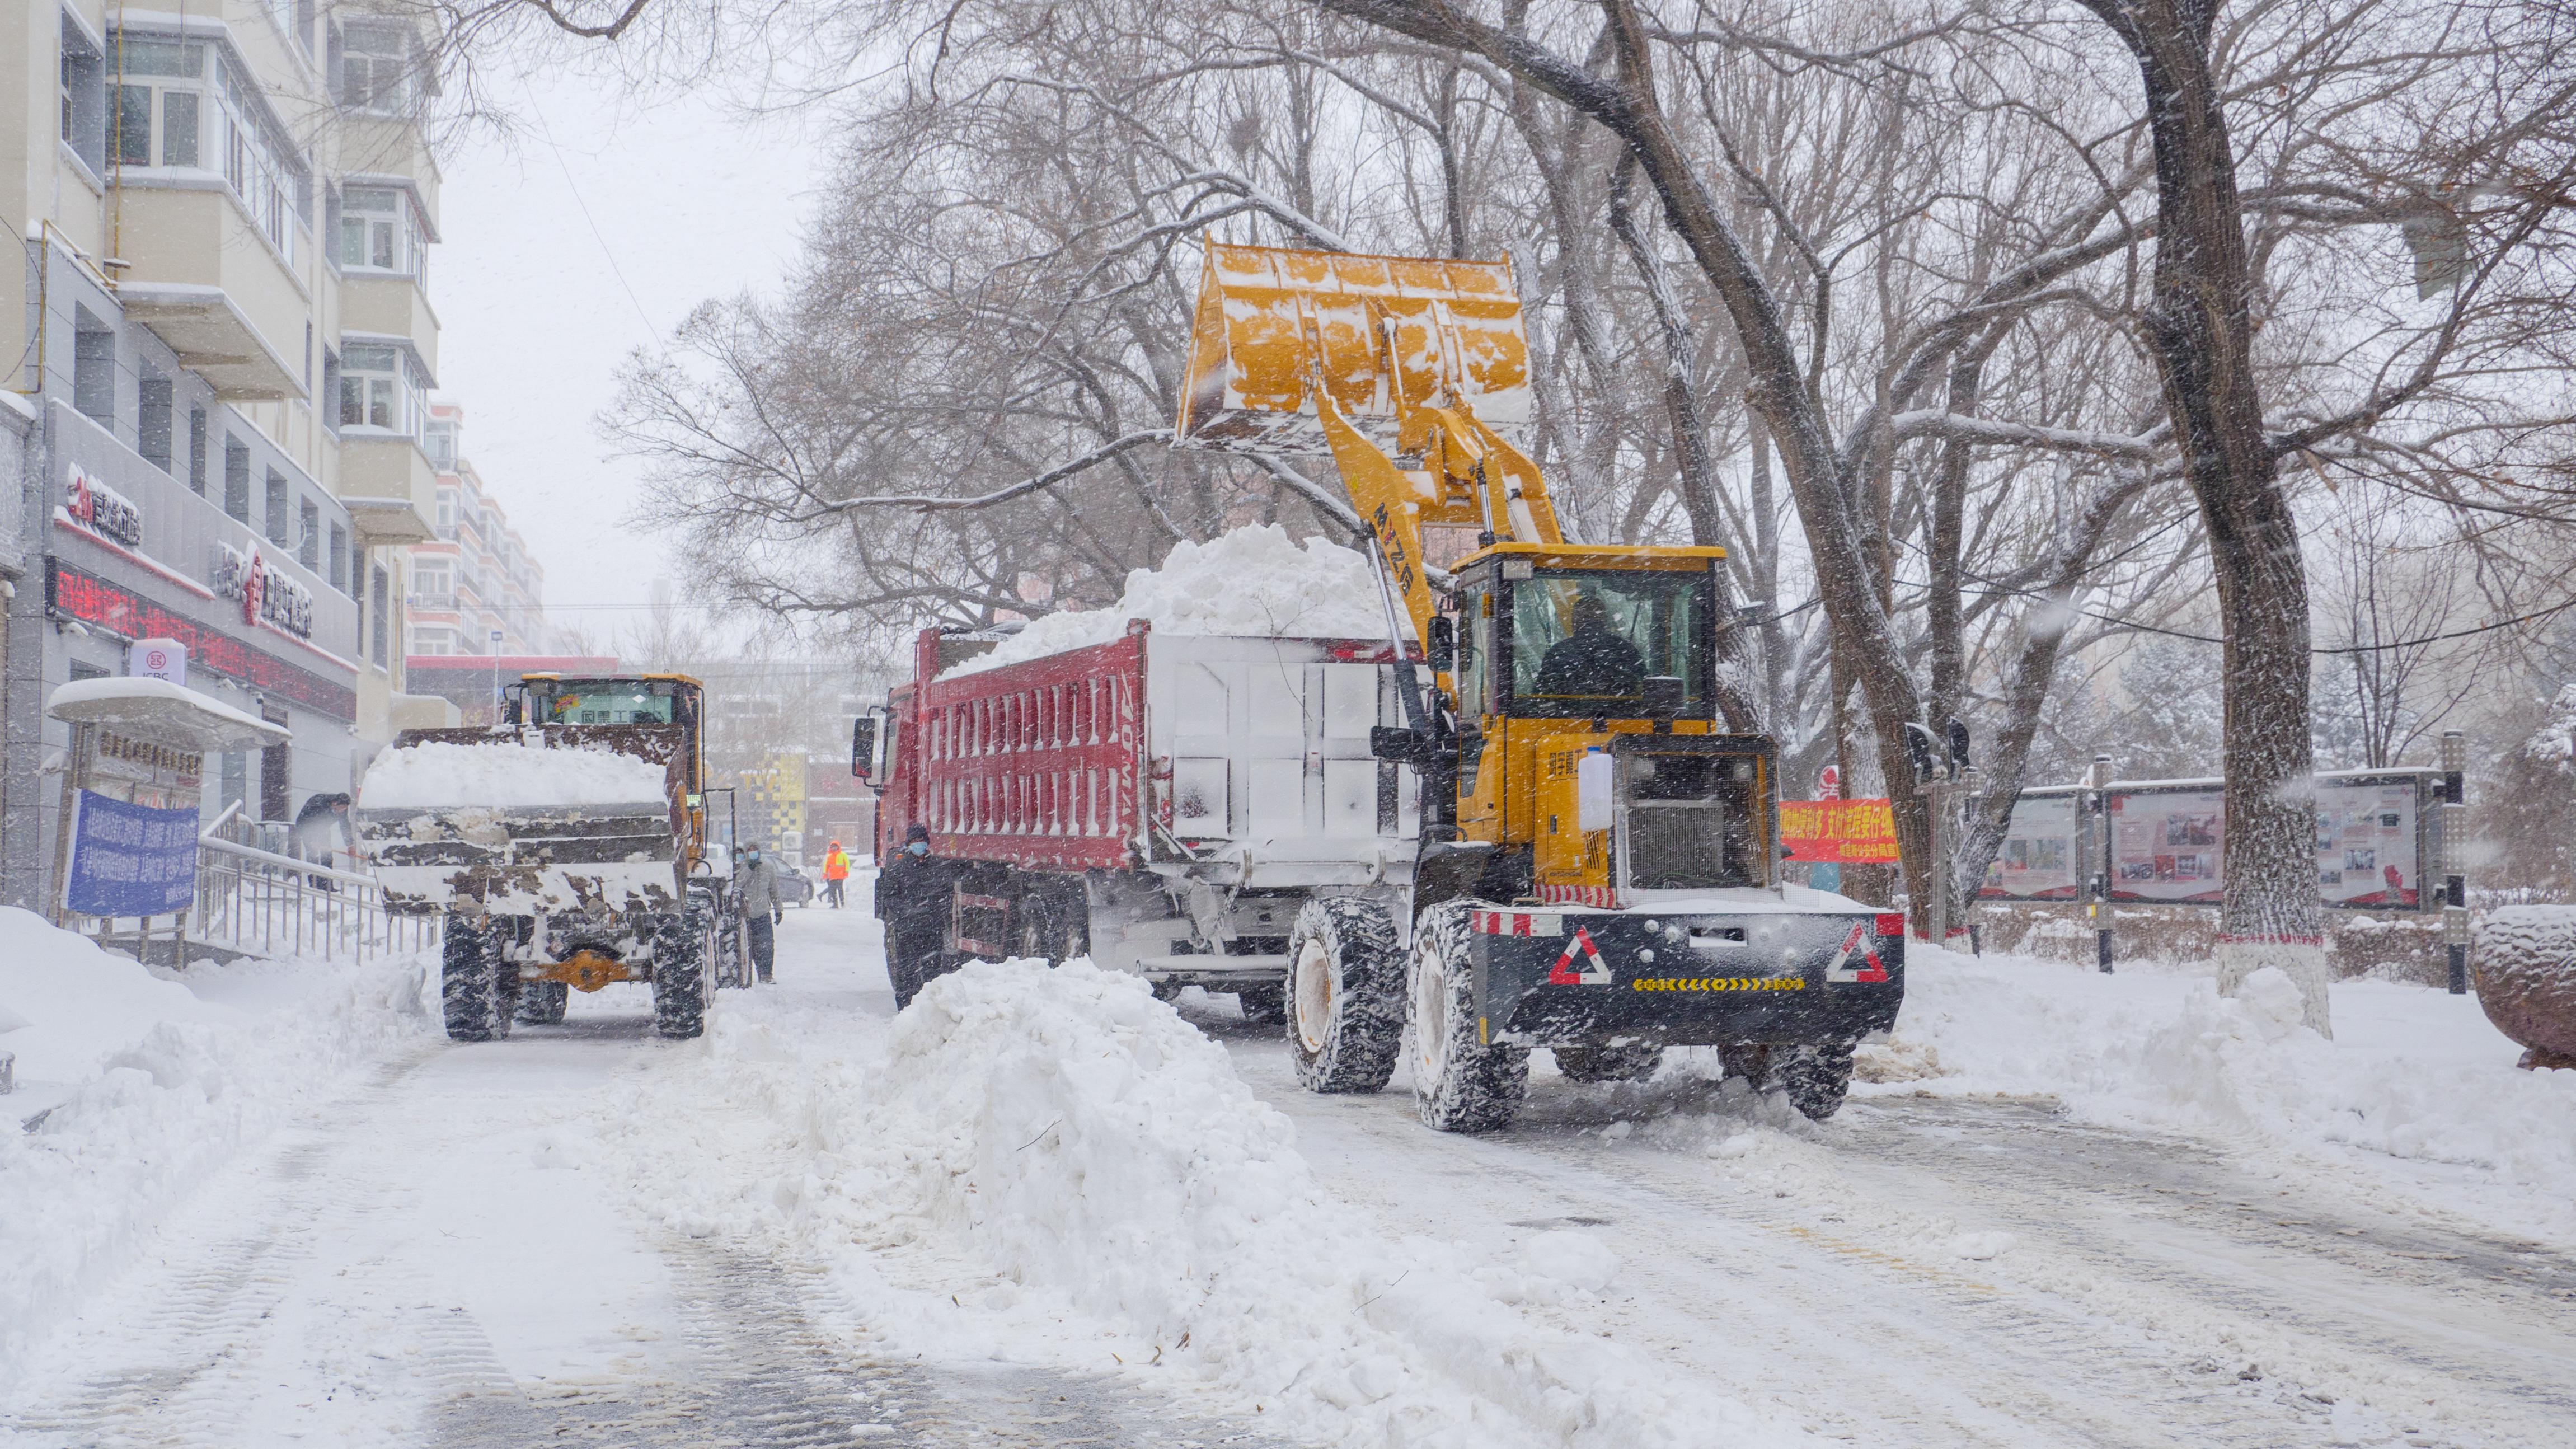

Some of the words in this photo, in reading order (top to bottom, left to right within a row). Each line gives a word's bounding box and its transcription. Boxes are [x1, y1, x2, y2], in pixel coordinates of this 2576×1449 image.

[1780, 806, 1824, 840] 购物便利多
[1826, 803, 1895, 840] 支付流程要仔细
